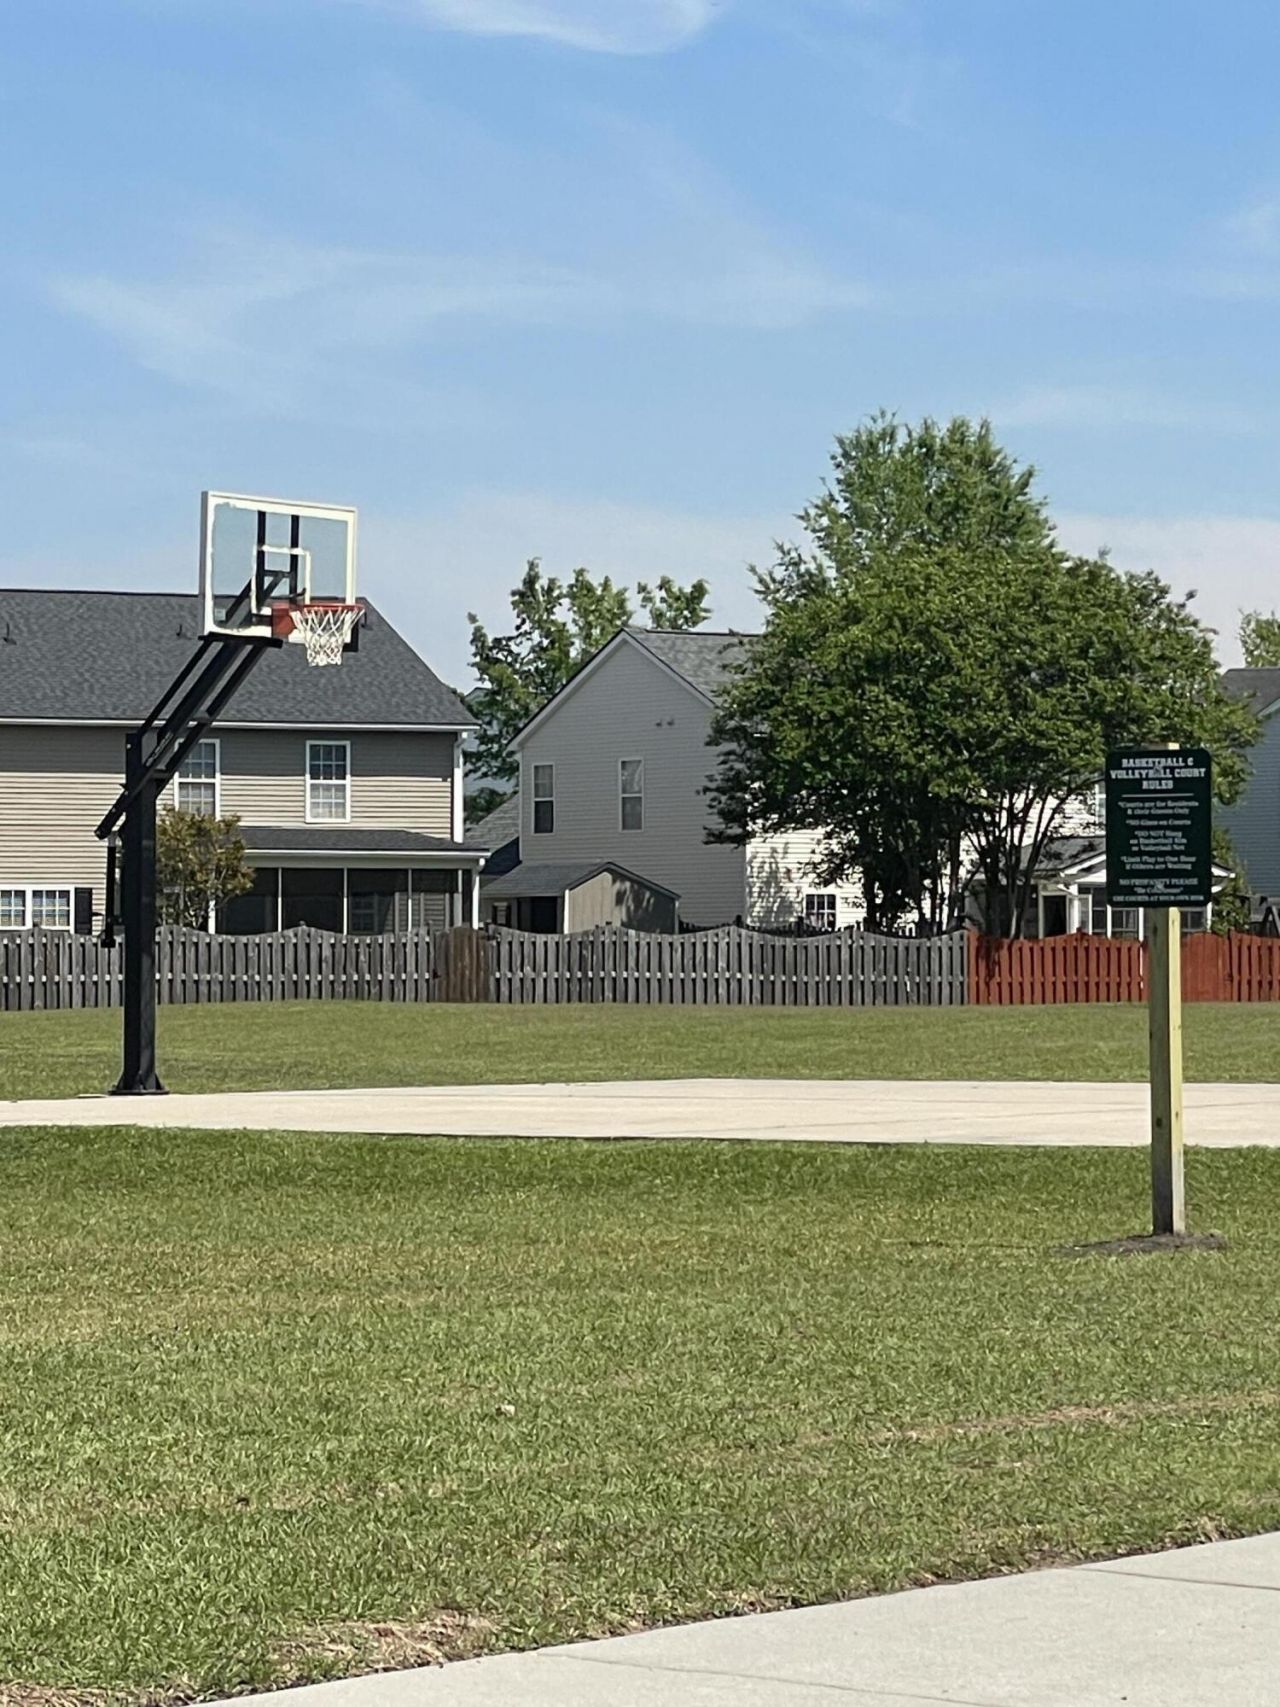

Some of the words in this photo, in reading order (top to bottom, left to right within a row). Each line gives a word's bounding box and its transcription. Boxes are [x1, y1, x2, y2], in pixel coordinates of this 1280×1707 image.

[1121, 757, 1186, 768] BASKETBALL
[1109, 769, 1173, 779] VOLLEYBALL
[1174, 768, 1206, 778] COURT
[1142, 780, 1174, 790] RULES
